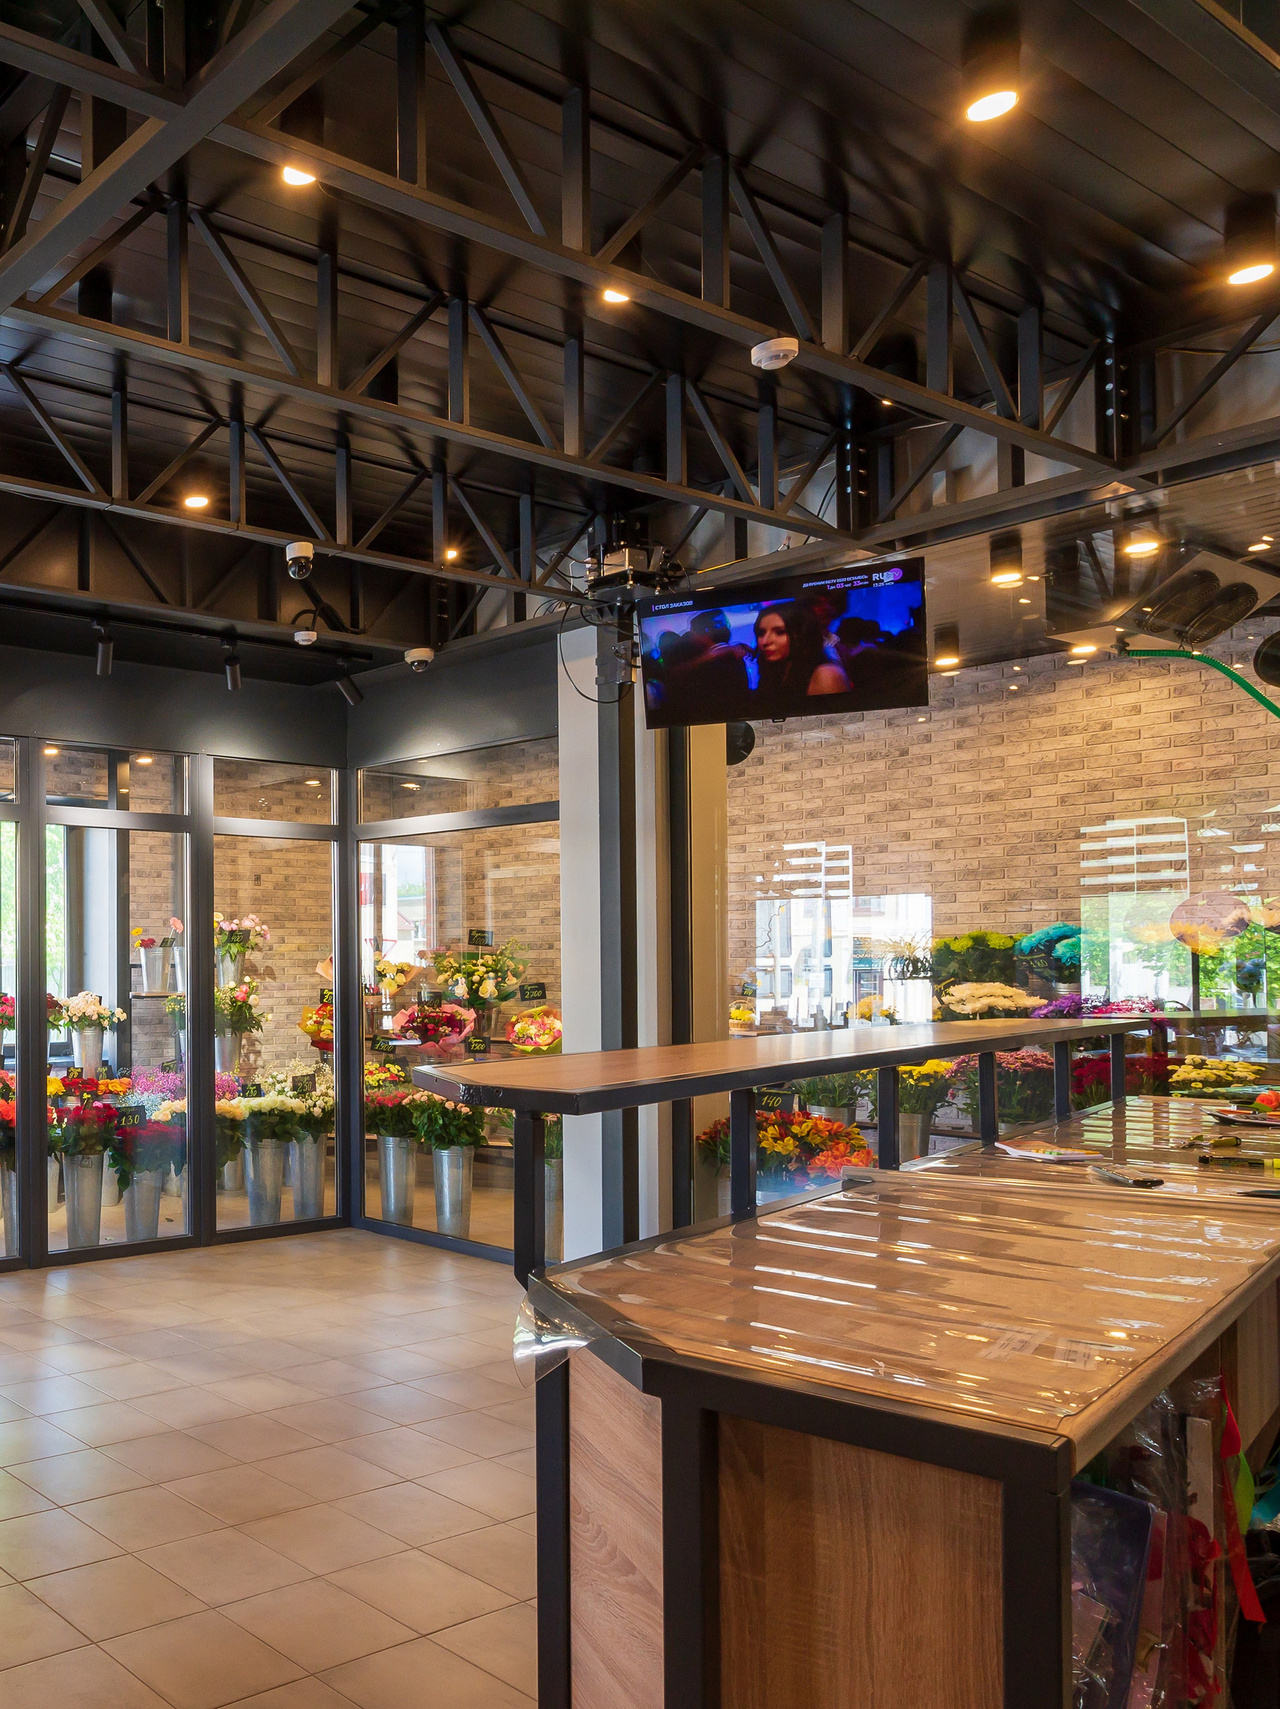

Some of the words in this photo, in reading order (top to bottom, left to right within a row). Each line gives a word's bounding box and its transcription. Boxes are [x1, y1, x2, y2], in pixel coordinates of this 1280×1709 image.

[670, 600, 693, 608] ЗАКАЗОВ
[524, 990, 542, 999] 2700
[762, 1095, 782, 1107] 140
[120, 1114, 140, 1126] 130
